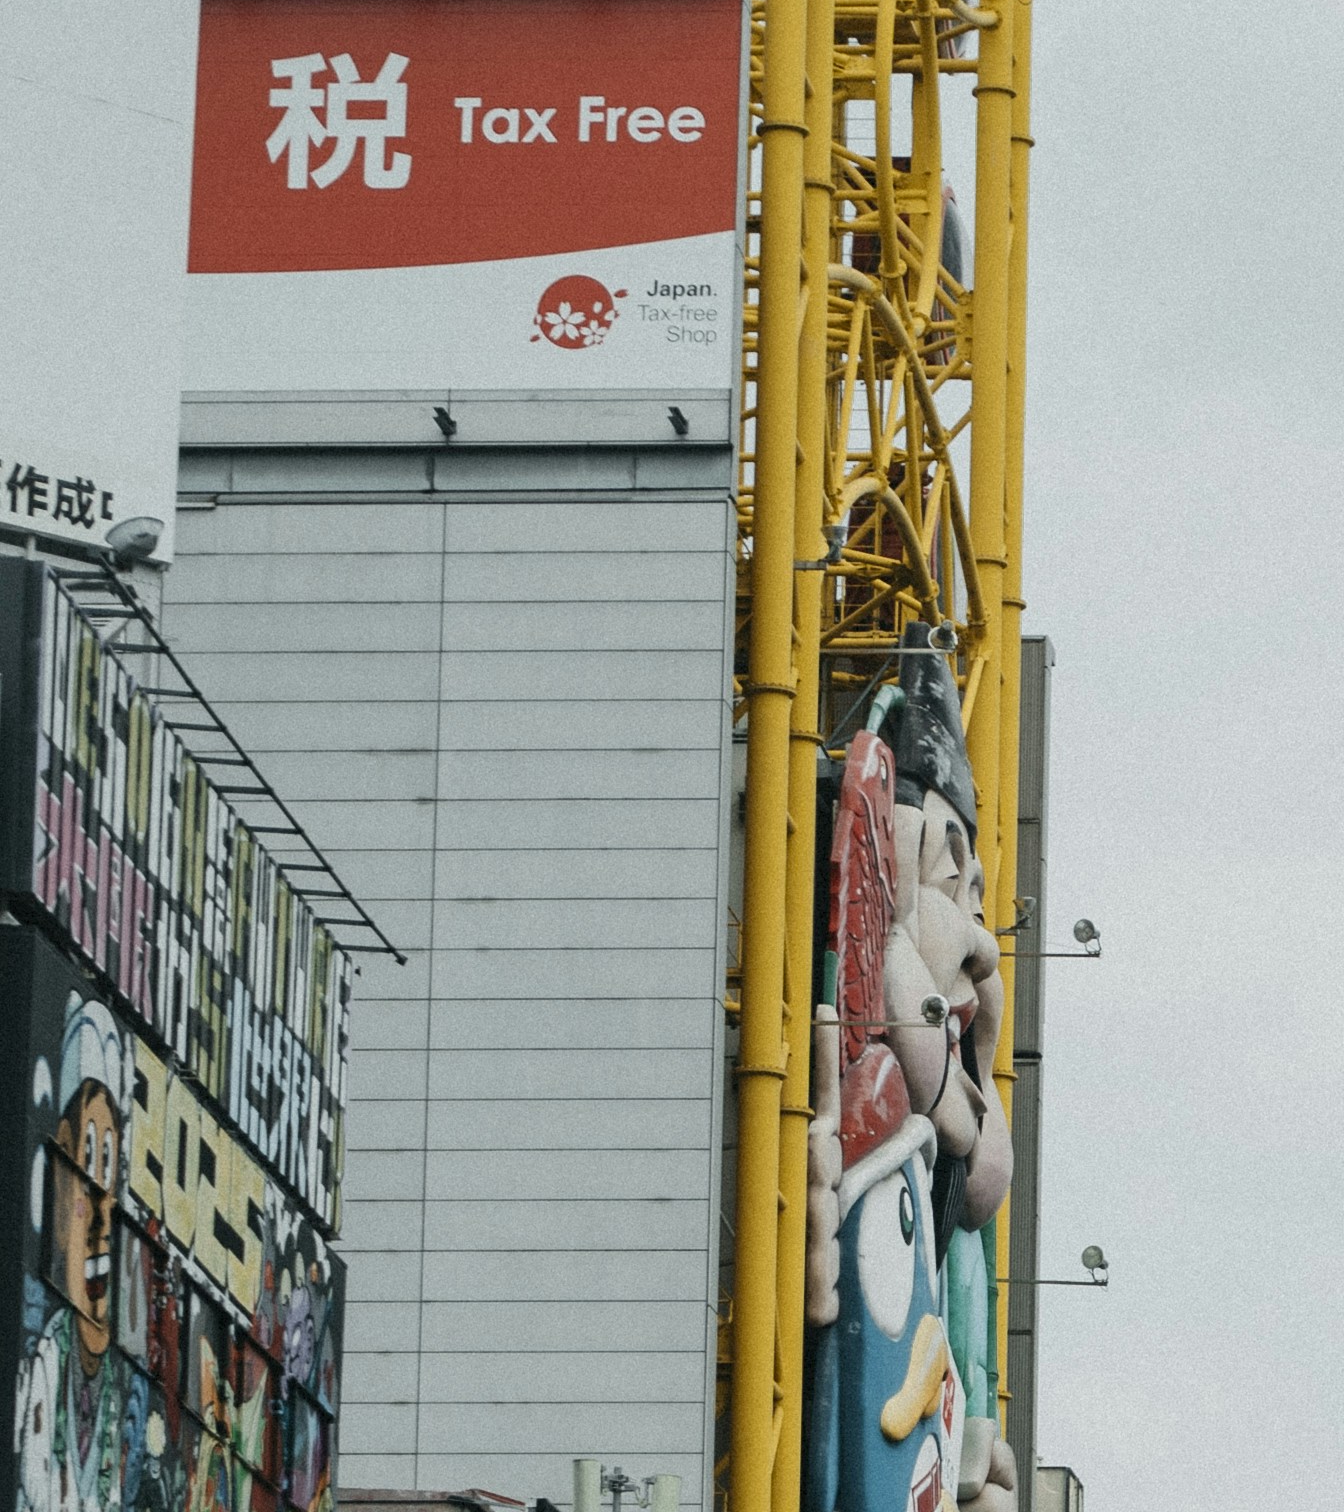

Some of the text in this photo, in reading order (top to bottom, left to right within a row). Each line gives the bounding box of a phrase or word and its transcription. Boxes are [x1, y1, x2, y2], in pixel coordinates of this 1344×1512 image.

[266, 52, 413, 190] 税
[454, 96, 706, 143] Tax Free
[647, 280, 718, 302] Japan.
[638, 304, 718, 321] Tax-free
[666, 327, 718, 346] Shop
